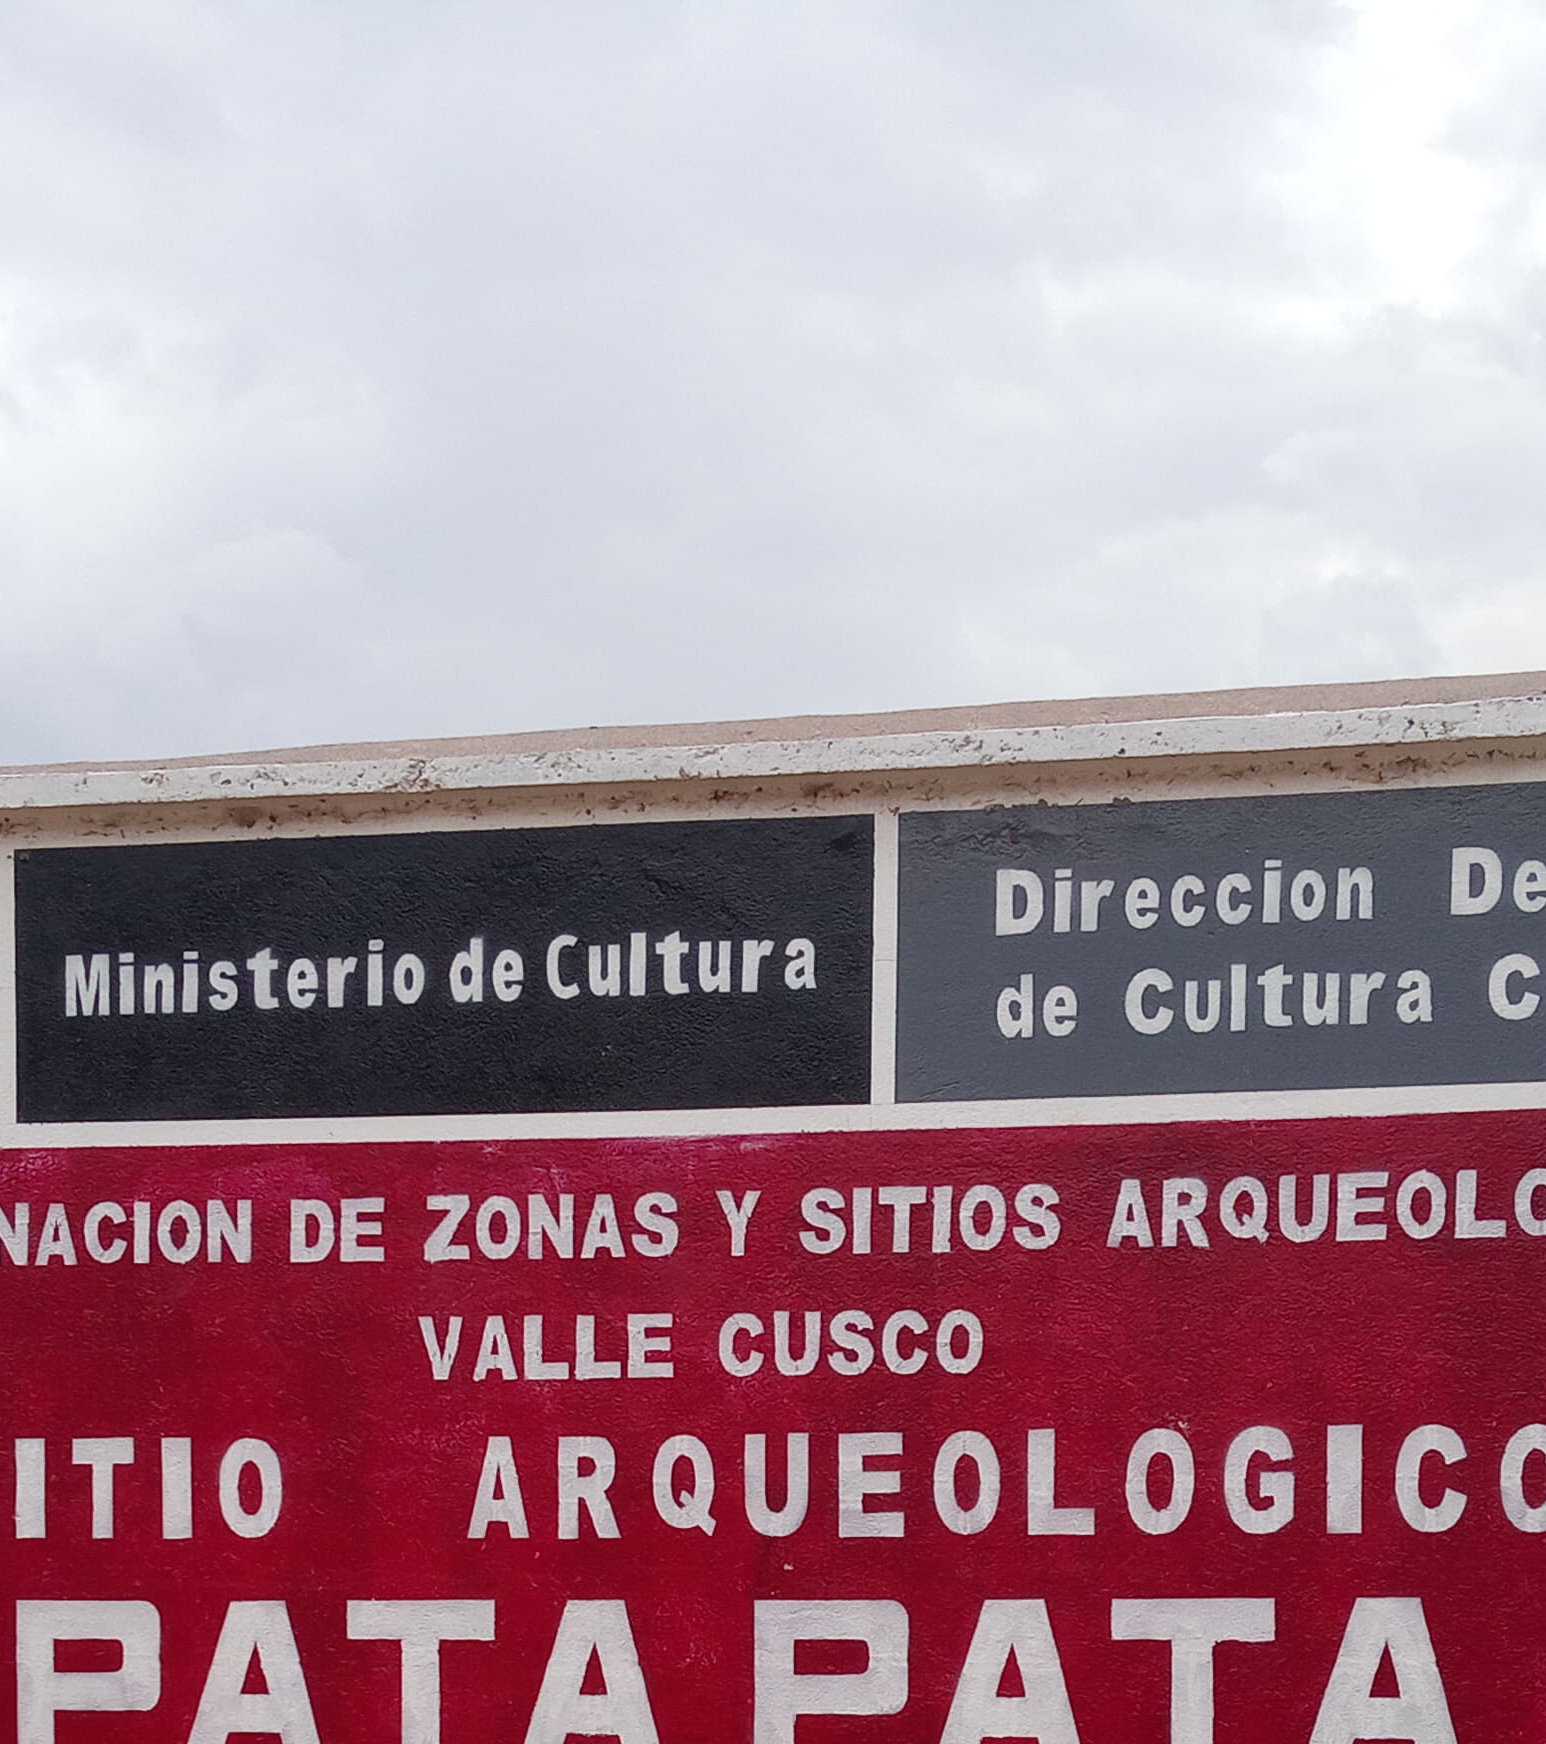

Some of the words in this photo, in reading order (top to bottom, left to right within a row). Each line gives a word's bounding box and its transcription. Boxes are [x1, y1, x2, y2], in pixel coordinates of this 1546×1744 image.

[995, 859, 1374, 936] Direccion
[65, 940, 425, 1017] Ministerio
[449, 938, 524, 1003] de
[546, 930, 818, 1000] Cultura
[996, 973, 1078, 1039] de
[1124, 963, 1433, 1035] Cultura
[289, 1196, 386, 1263] DE
[423, 1191, 679, 1264] ZONAS
[715, 1189, 762, 1257] Y
[798, 1183, 1062, 1255] SITIOS
[418, 1312, 674, 1382] VALLE
[718, 1308, 984, 1378] CUSCO
